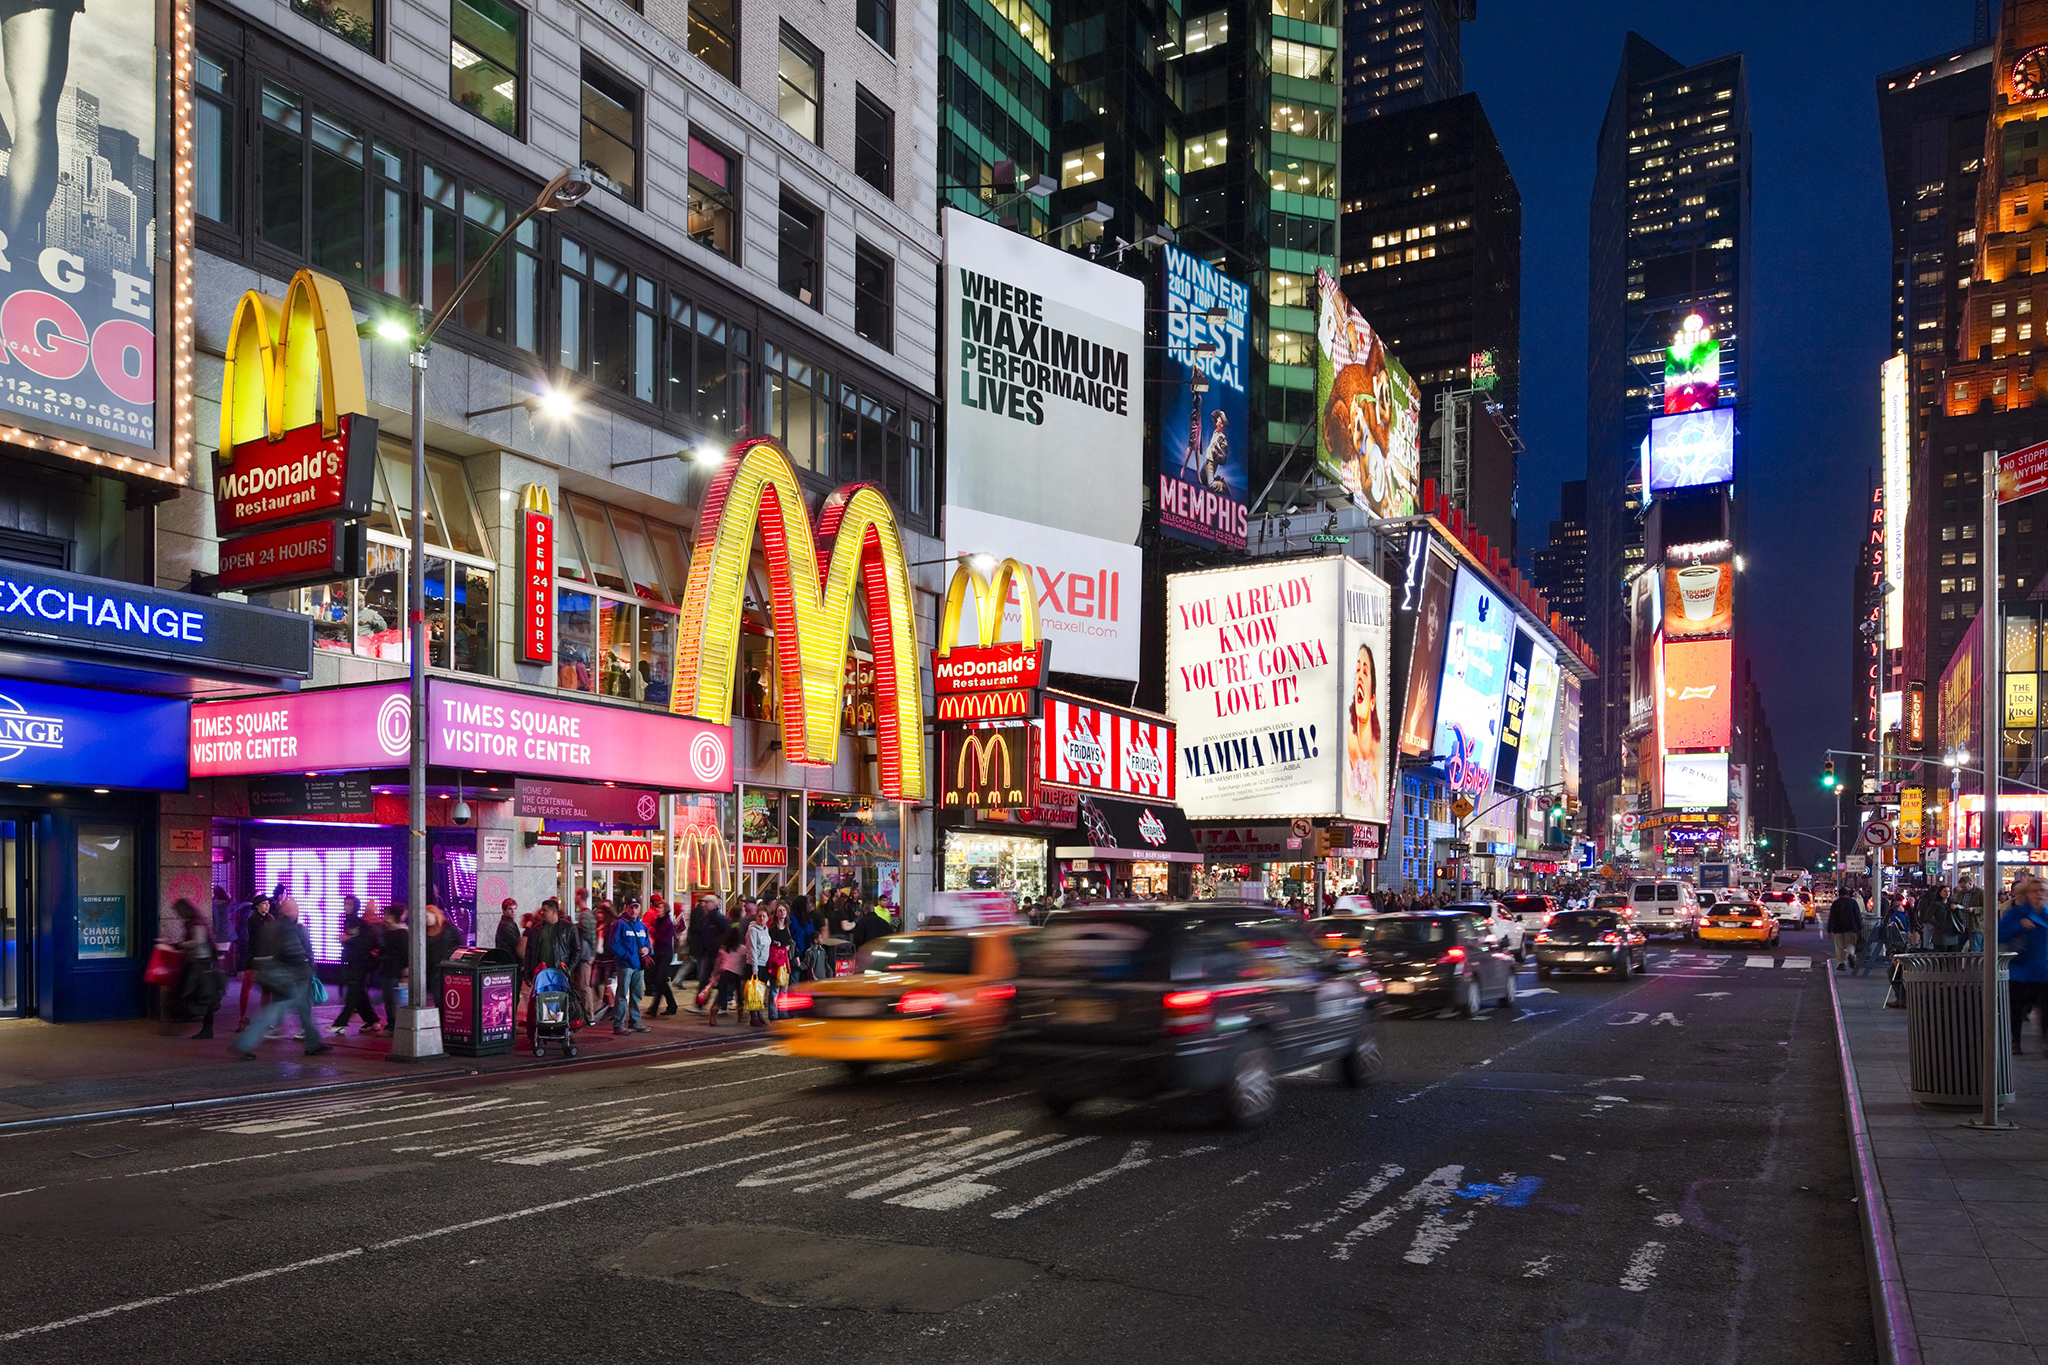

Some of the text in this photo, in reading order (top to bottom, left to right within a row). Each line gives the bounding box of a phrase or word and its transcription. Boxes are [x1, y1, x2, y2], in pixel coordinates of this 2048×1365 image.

[960, 267, 1043, 322] WHERE
[1164, 243, 1247, 312] WINNER!
[1169, 273, 1191, 299] 2010
[1193, 285, 1216, 309] TONY
[961, 298, 1129, 390] MAXIMUM
[1168, 292, 1244, 366] BEST
[1674, 329, 1710, 346] 2010
[961, 340, 1128, 416] PERFORMANCE
[1168, 334, 1244, 392] MUSICAL
[961, 369, 1045, 425] LIVES
[7, 393, 154, 441] 49TH ST. AT BROADWAY
[218, 450, 339, 501] McDonald's
[2003, 459, 2015, 471] NO
[235, 485, 316, 517] Restaurant
[1160, 474, 1248, 538] MEMPHIS
[1162, 512, 1209, 532] TELECHARGE.COM
[1870, 488, 1884, 585] ERNST
[220, 538, 327, 572] OPEN 24 HOURS
[536, 521, 545, 571] OPEN
[533, 575, 548, 588] 24
[0, 580, 204, 642] XCHANGE
[1179, 575, 1314, 630] YOU ALREADY
[1346, 589, 1371, 625] MAMMA
[536, 591, 545, 654] HOURS
[1218, 614, 1279, 654] KNOW
[937, 655, 1036, 678] McDonald's
[952, 674, 1018, 688] Restaurant
[1180, 638, 1328, 692] YOU'RE GONNA
[1214, 674, 1299, 718] LOVE IT!
[2009, 694, 2033, 706] LION
[2013, 683, 2030, 691] THE
[193, 710, 288, 738] TIMES SQUARE
[443, 699, 580, 738] TIMES SQUARE
[2008, 707, 2034, 720] KING
[193, 736, 297, 763] VISITOR CENTER
[443, 729, 591, 765] VISITOR CENTER
[1183, 724, 1319, 779] MAMMA MIA!
[1242, 769, 1265, 779] MUSICAL
[1283, 763, 1301, 771] ABBA
[1681, 766, 1719, 784] FRINGE
[522, 786, 552, 795] HOME OF
[522, 795, 574, 807] THE CENTENNIAL
[522, 805, 588, 817] NEW YEAR'S EVE BALL
[1206, 843, 1281, 853] COMPUTERS
[83, 927, 120, 935] CHANGE
[83, 936, 120, 945] TODAY!
